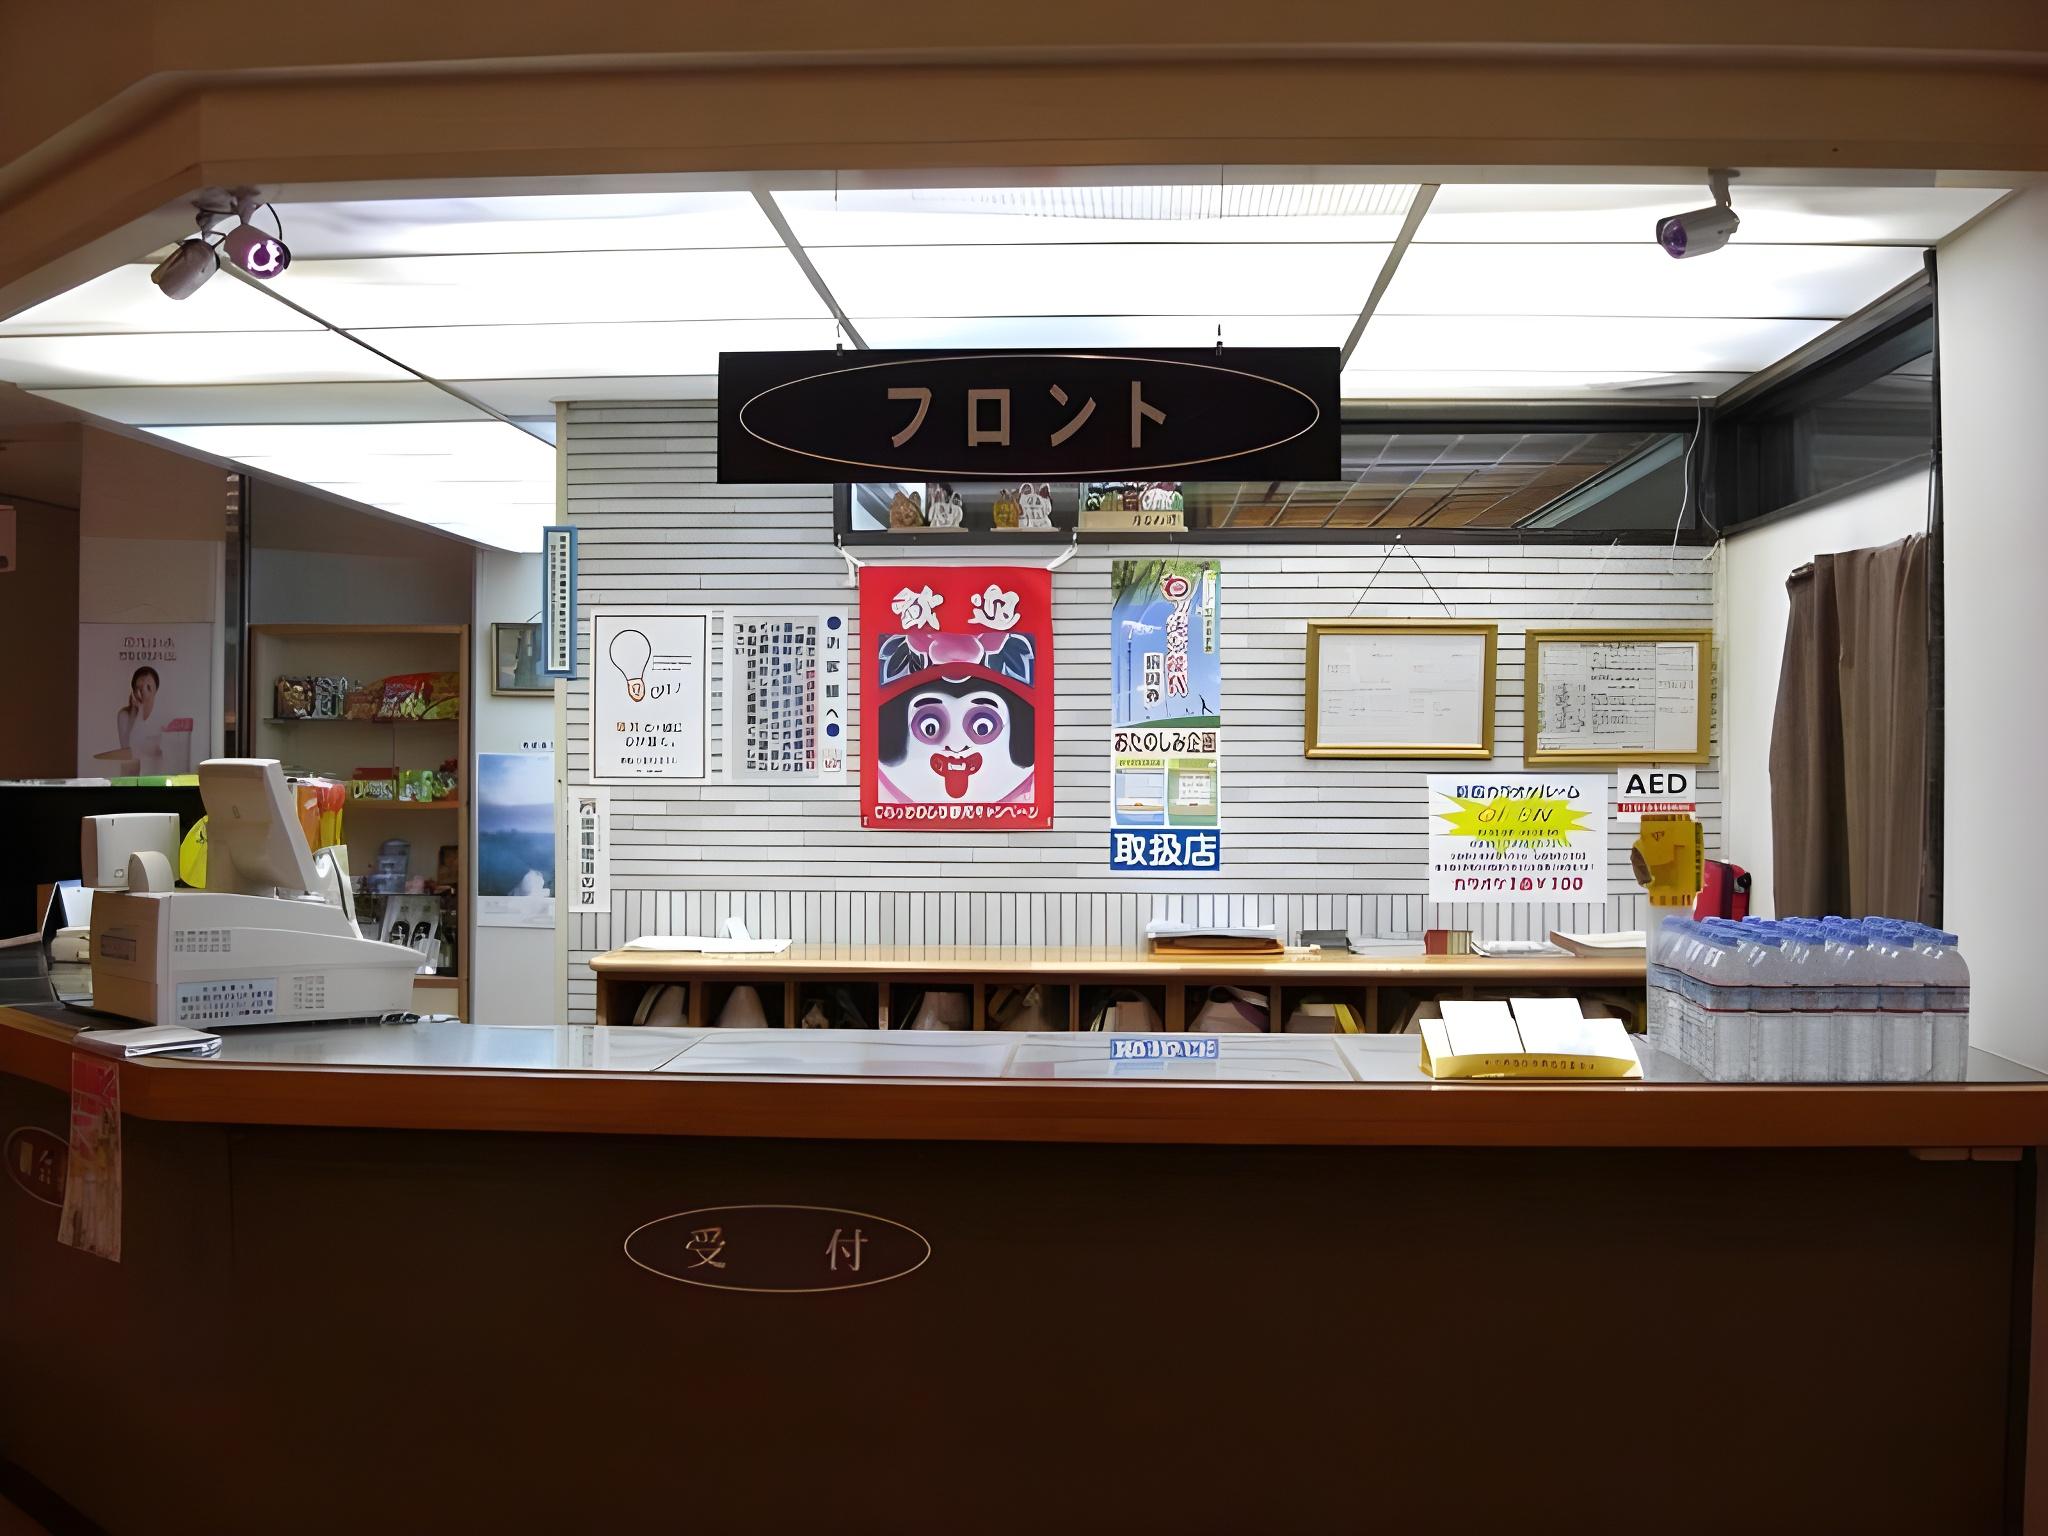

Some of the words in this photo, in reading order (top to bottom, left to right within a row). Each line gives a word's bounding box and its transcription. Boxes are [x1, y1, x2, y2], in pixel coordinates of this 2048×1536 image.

[886, 380, 1168, 449] フロント
[1625, 773, 1688, 795] AED
[1114, 832, 1217, 867] 取扱店
[685, 1226, 869, 1271] 受付
